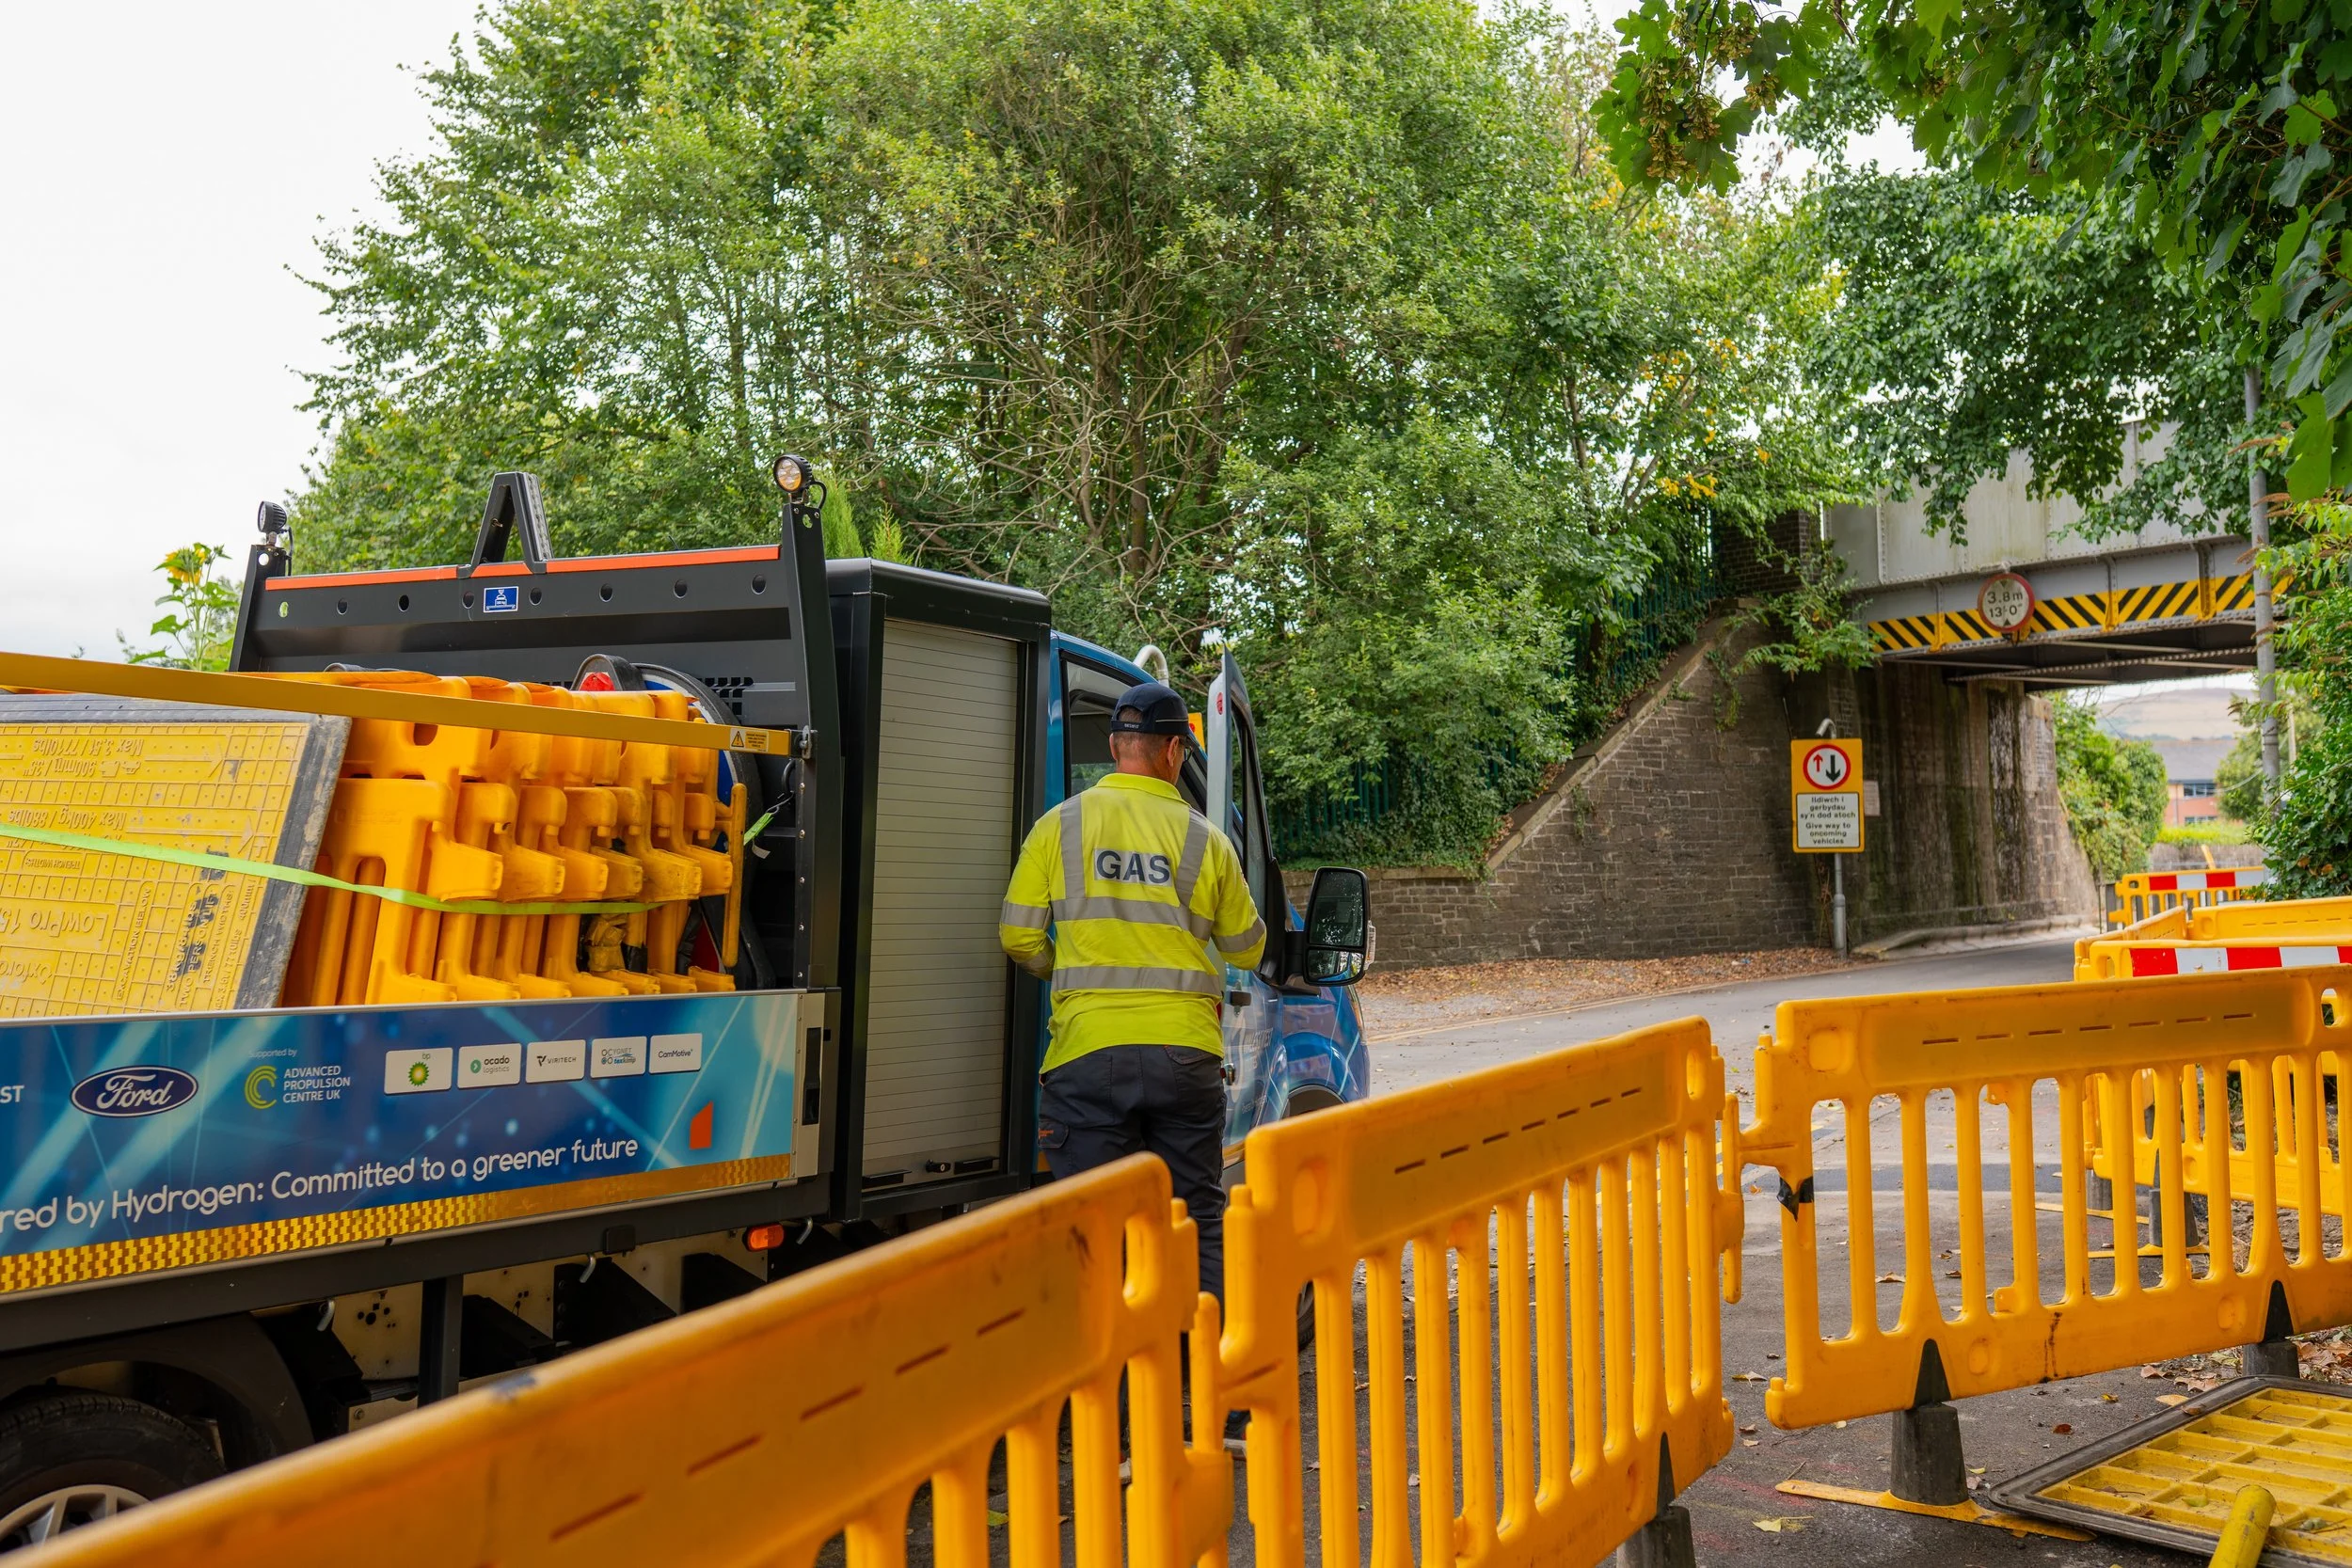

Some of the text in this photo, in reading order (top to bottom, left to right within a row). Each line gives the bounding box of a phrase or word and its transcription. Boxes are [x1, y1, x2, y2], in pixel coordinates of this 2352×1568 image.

[116, 738, 144, 756] Max
[99, 812, 127, 831] Max
[1096, 850, 1170, 883] GAS
[30, 911, 109, 941] LowPro
[116, 888, 151, 1001] EXCAVATION BELOW
[179, 975, 194, 1006] TWO
[188, 919, 209, 974] PERSON
[248, 1048, 298, 1059] Supported by
[484, 1055, 510, 1066] ocado
[547, 1056, 577, 1065] VIRITECH
[283, 1065, 342, 1079] ADVANCED
[483, 1065, 510, 1074] logistics
[96, 1073, 174, 1109] Ford
[283, 1077, 351, 1091] PROPULSION
[283, 1089, 341, 1103] CENTRE UK
[66, 1196, 104, 1227] by
[111, 1181, 264, 1223] Hydrogen:
[271, 1159, 415, 1199] Committed
[421, 1156, 445, 1182] to
[451, 1161, 467, 1178] a
[472, 1147, 566, 1181] greener
[571, 1136, 639, 1164] future
